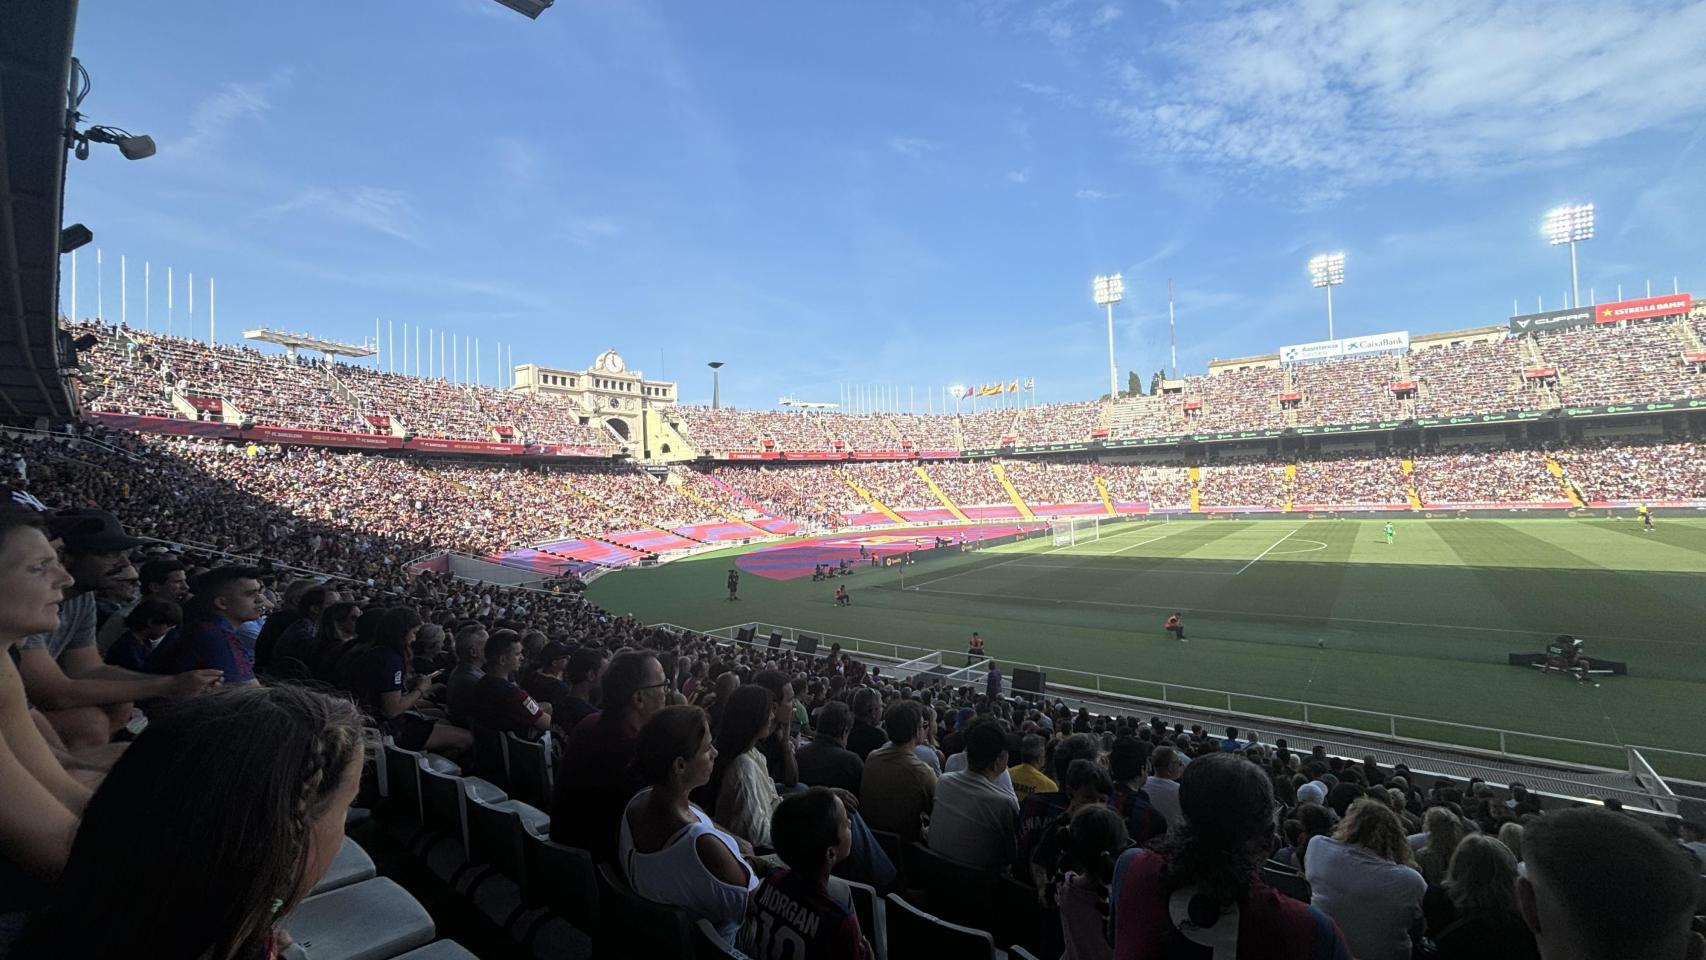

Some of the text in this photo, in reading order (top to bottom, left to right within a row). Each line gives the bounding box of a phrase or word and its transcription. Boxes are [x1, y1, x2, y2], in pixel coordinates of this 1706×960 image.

[1614, 301, 1686, 316] ESTRELLA DAMM
[1534, 312, 1590, 324] CUPRA
[1359, 337, 1404, 348] CaixaBank
[759, 884, 821, 939] MORGAN
